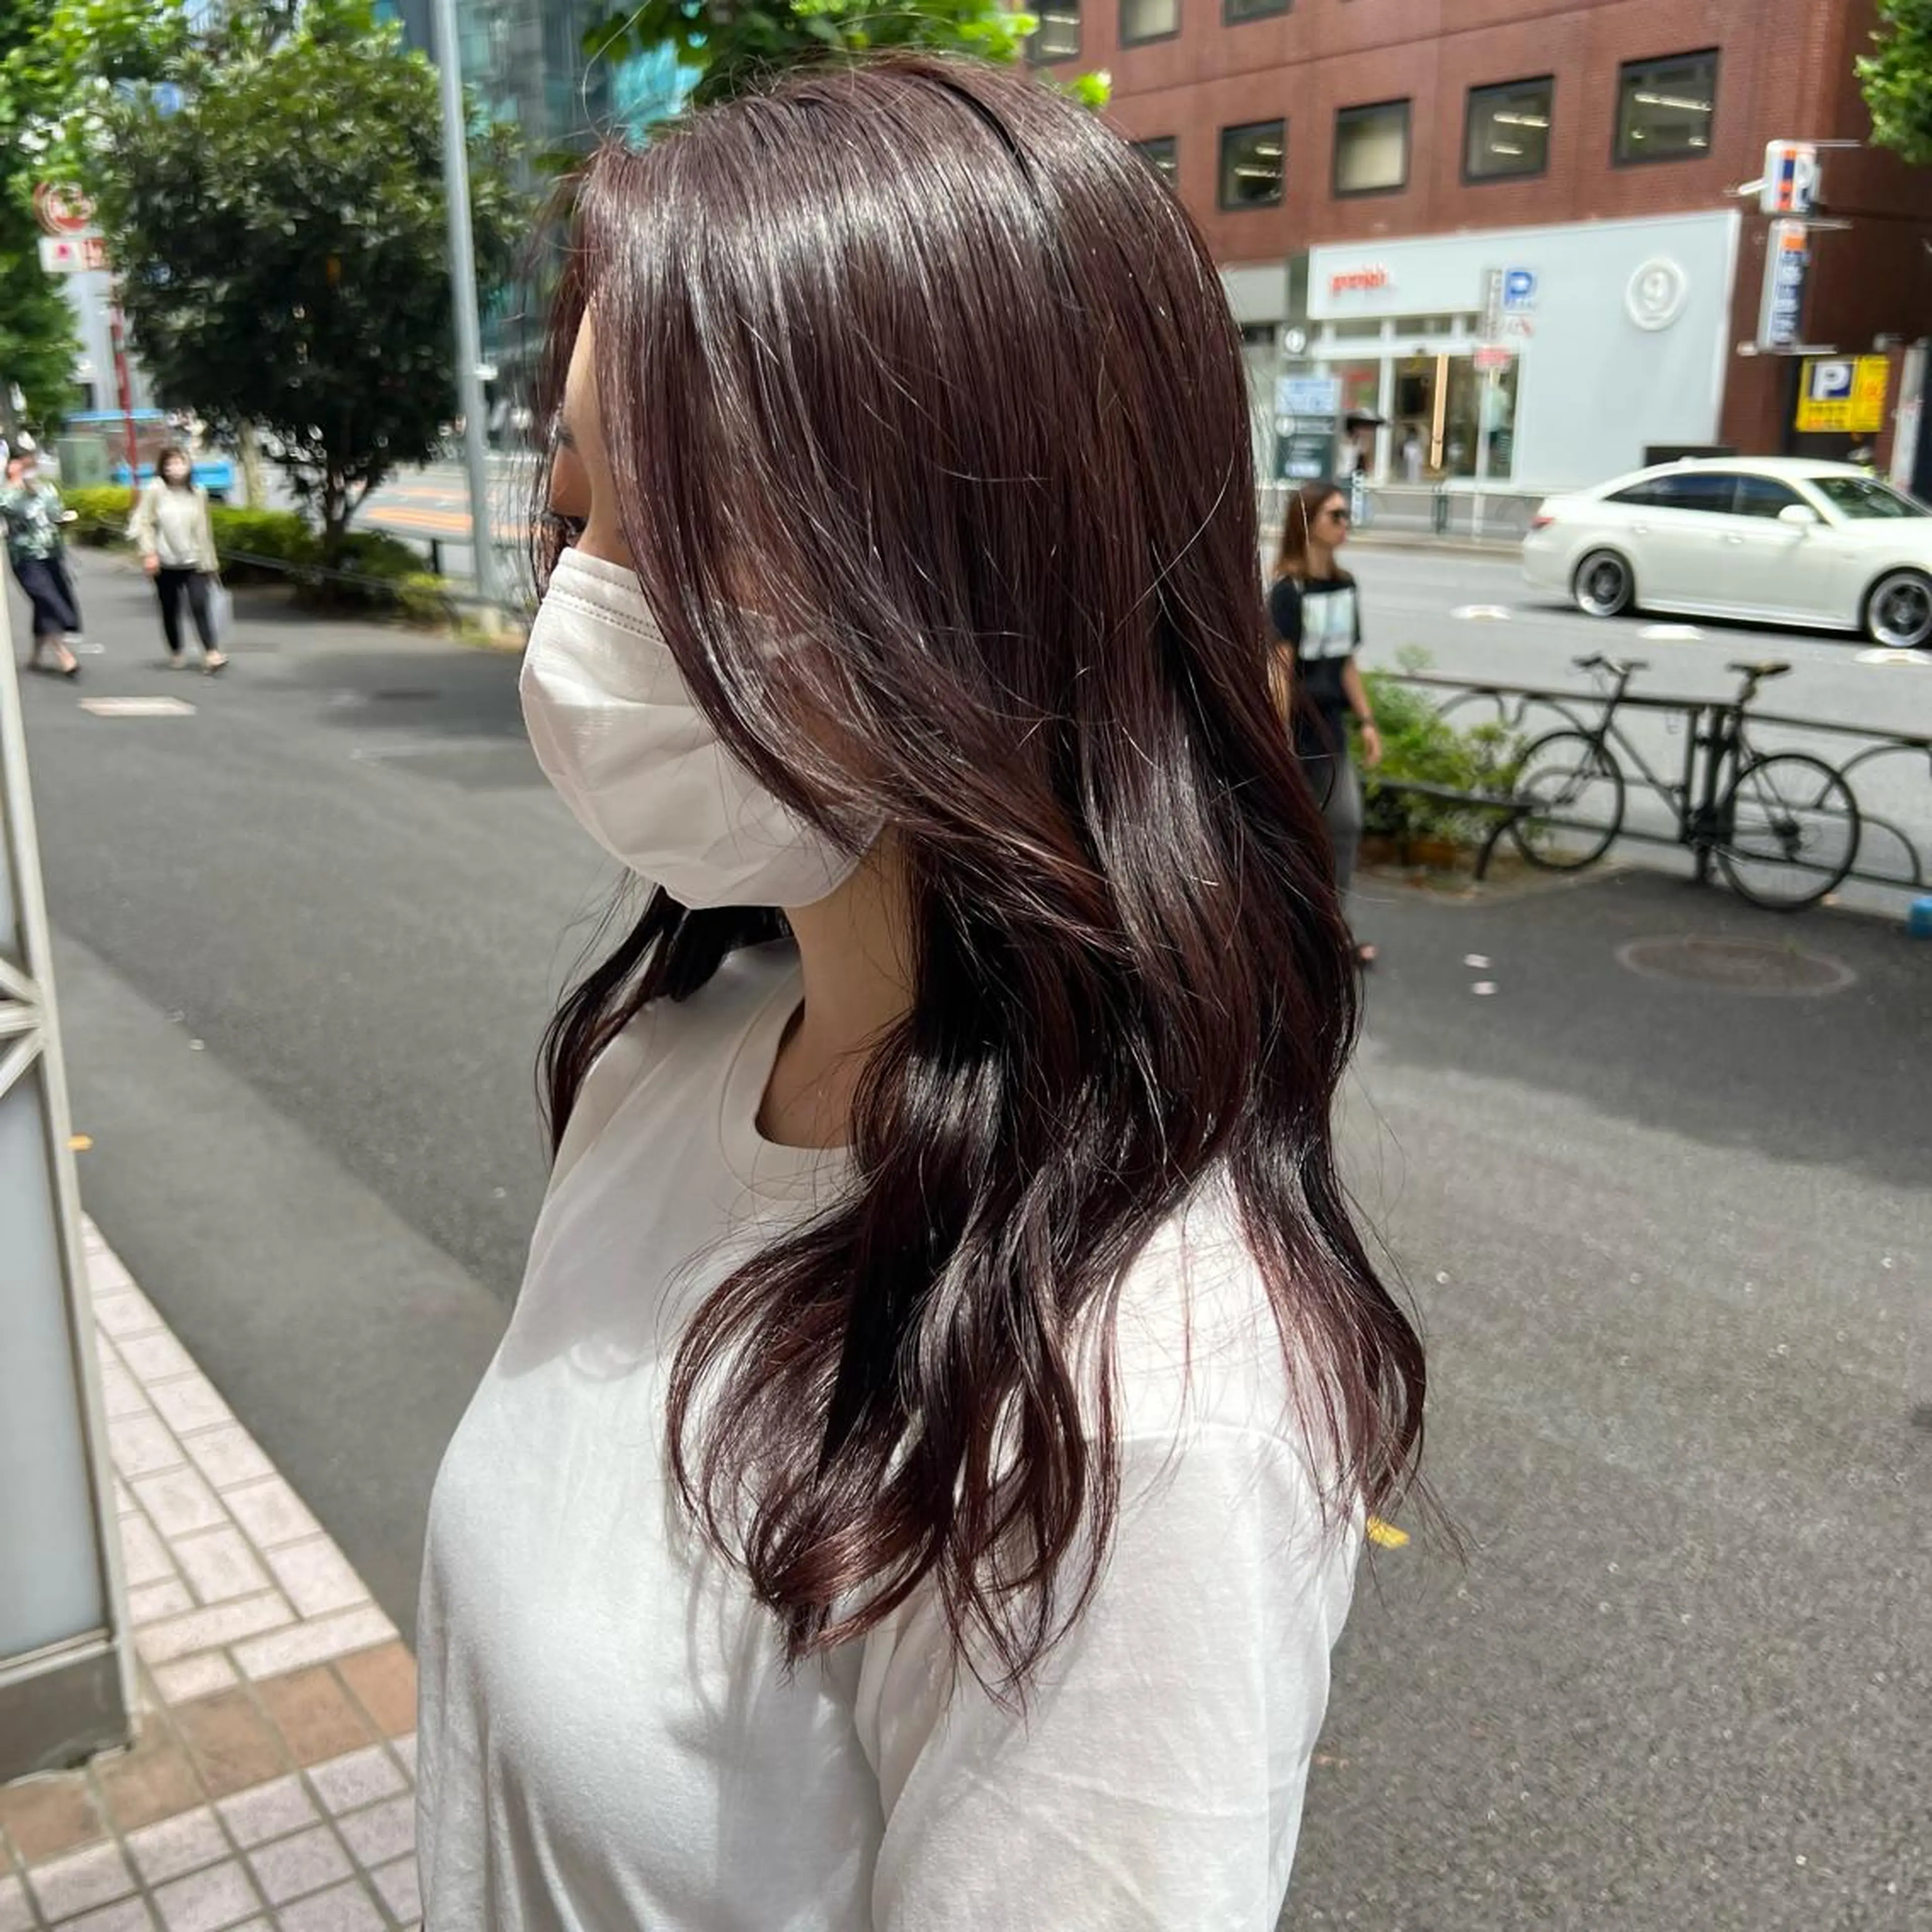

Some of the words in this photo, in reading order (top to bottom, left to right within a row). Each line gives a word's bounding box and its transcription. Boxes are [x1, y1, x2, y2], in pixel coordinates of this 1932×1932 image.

[1504, 271, 1534, 306] P
[1642, 271, 1669, 310] 9
[1812, 361, 1849, 400] P
